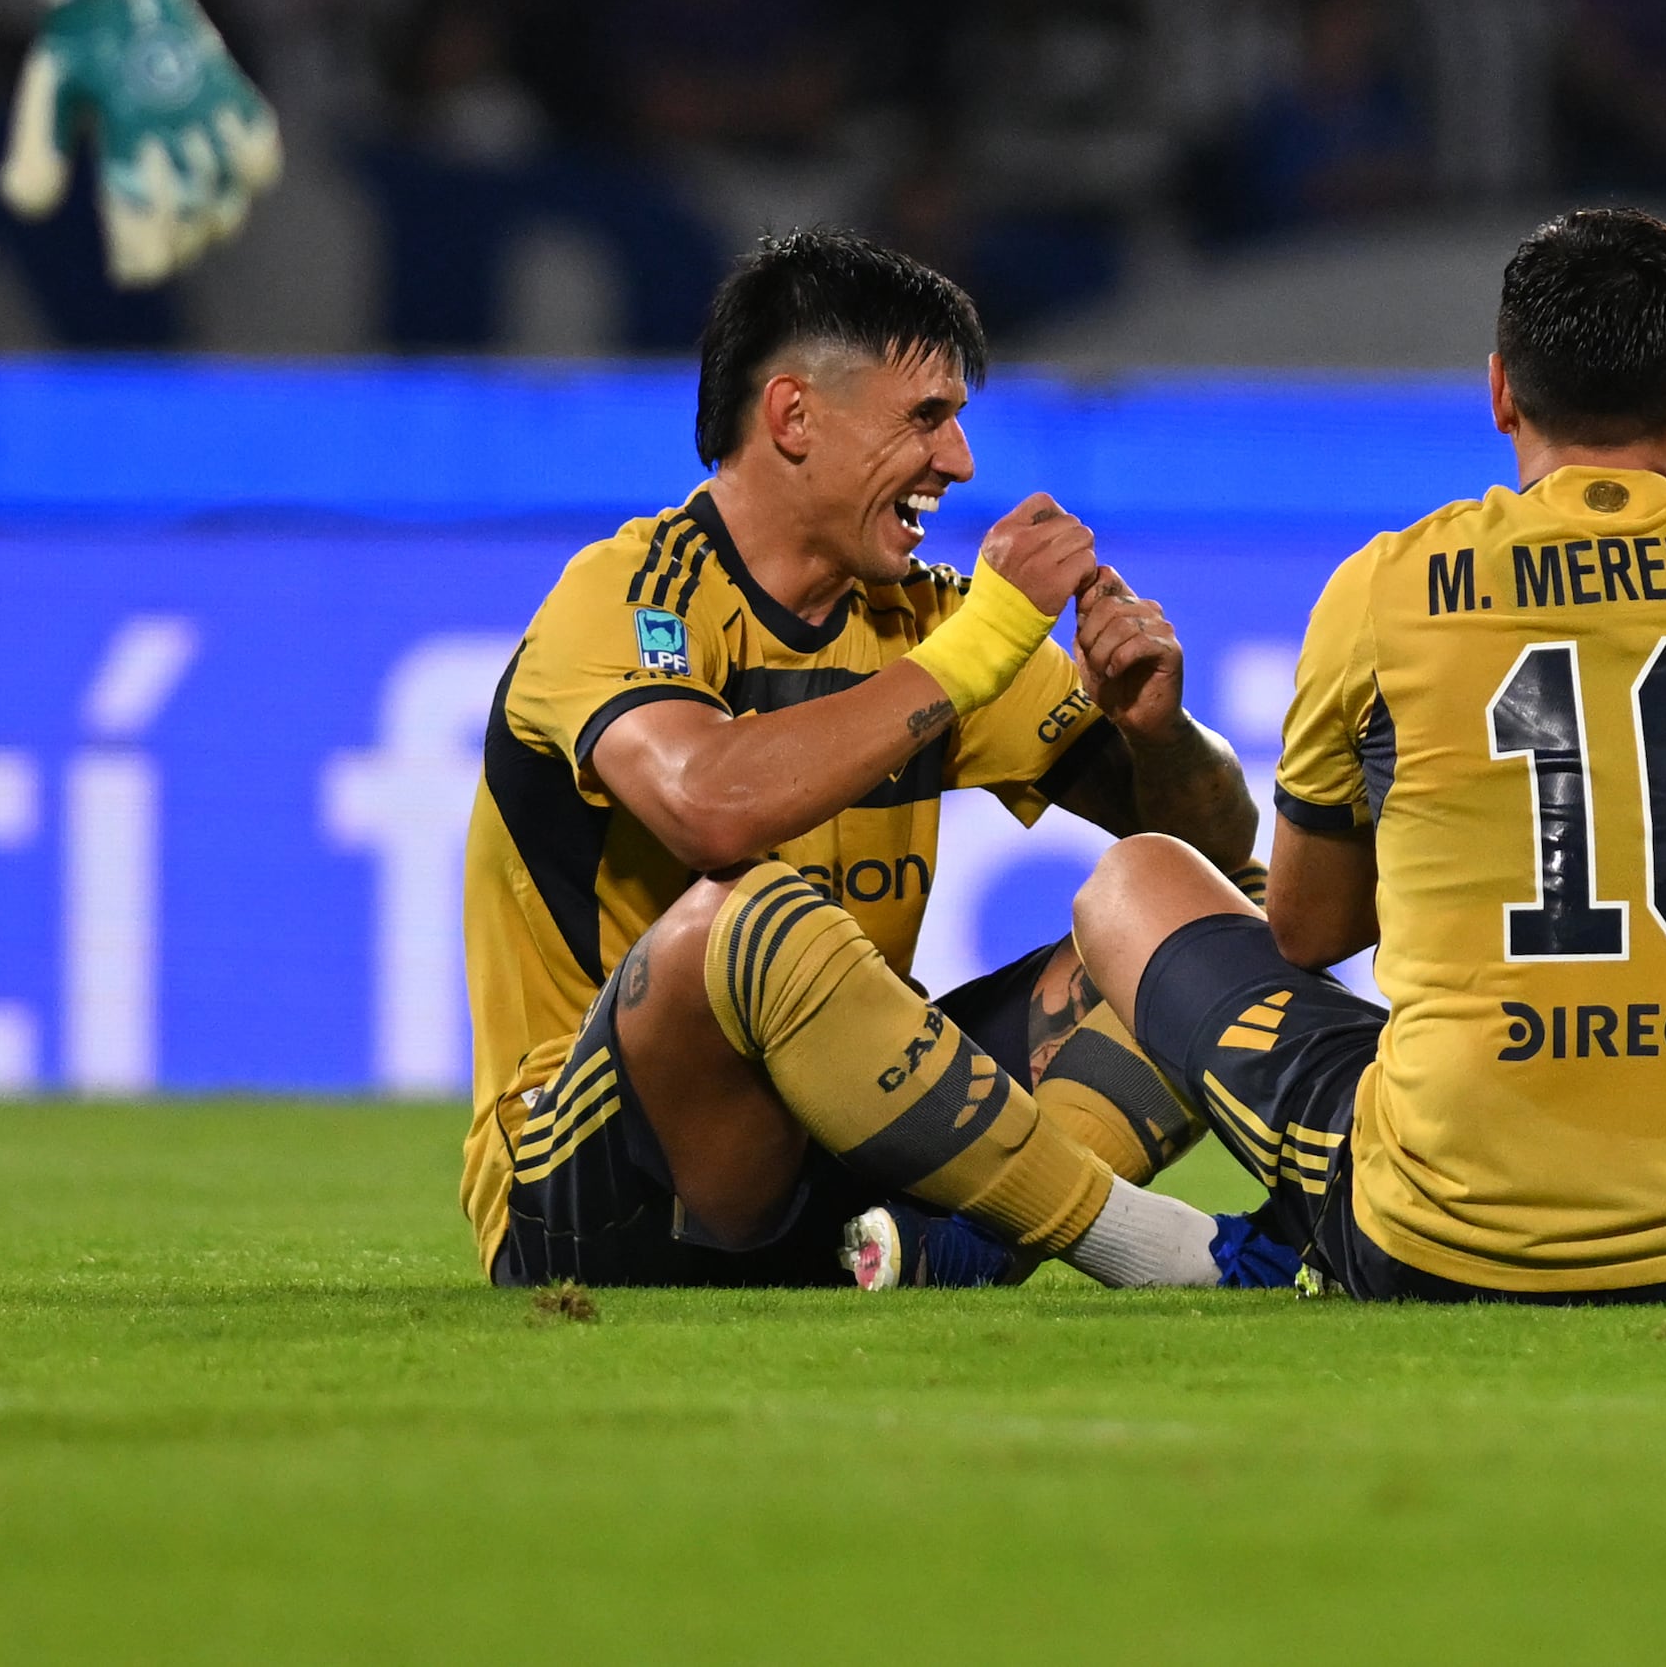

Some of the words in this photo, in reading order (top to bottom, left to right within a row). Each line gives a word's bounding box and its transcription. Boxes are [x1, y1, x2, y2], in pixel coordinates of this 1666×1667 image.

[1428, 547, 1493, 616] M.
[643, 651, 688, 671] LPF
[877, 1002, 945, 1094] CAB
